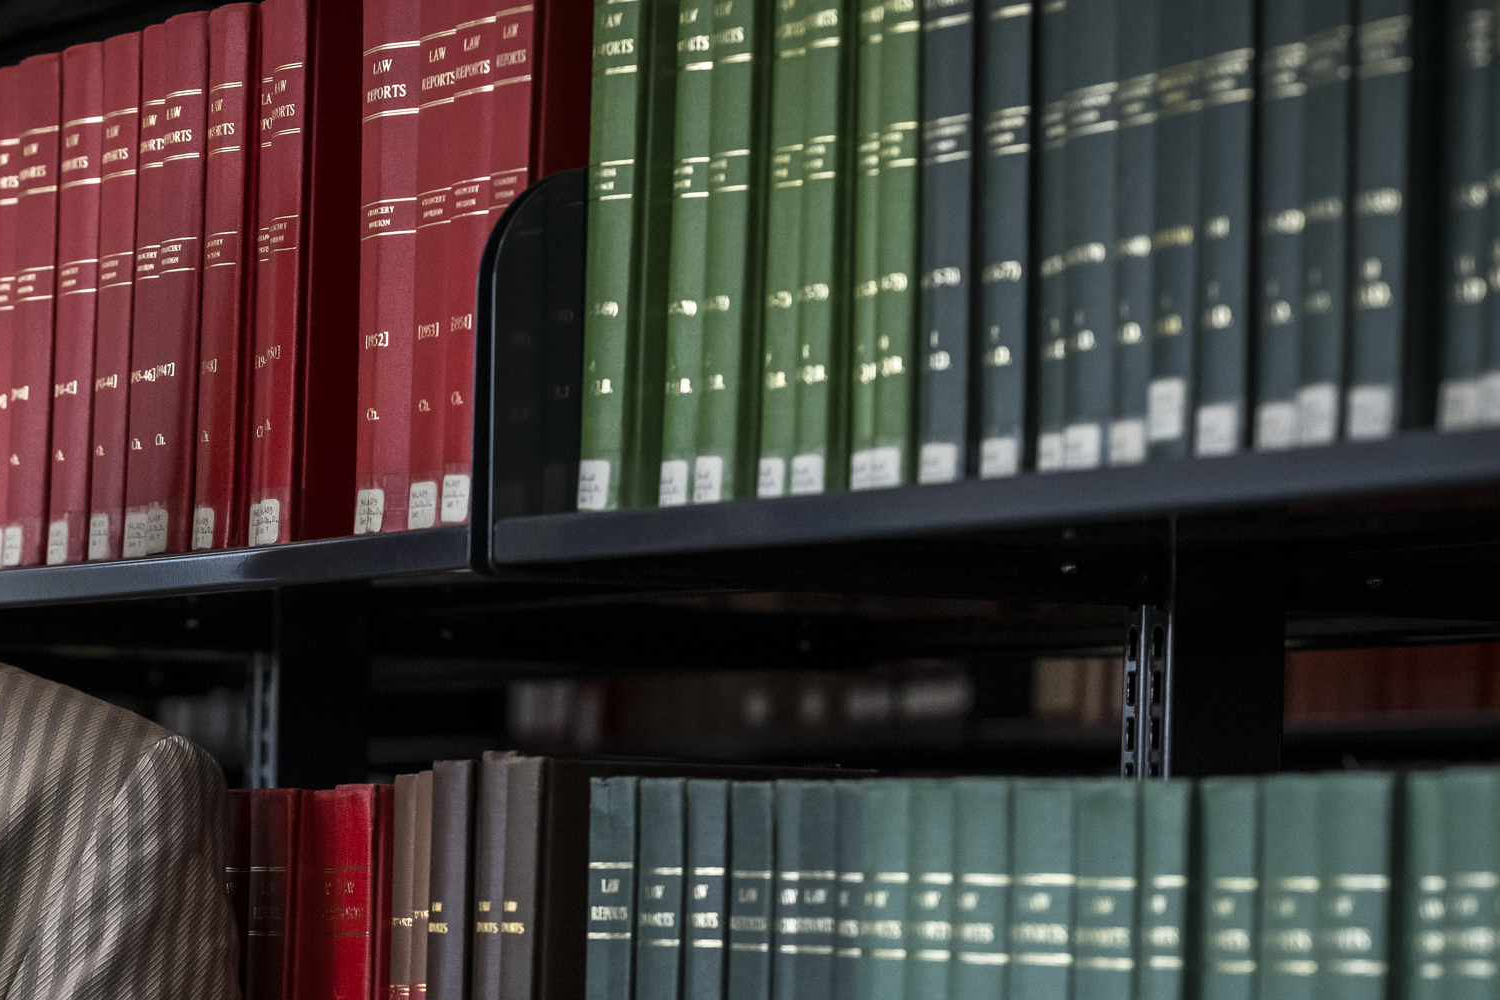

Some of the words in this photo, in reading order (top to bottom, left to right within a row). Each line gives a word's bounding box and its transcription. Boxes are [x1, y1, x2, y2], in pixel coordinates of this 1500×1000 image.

[503, 23, 519, 40] LAW
[464, 34, 481, 52] LAW
[429, 46, 447, 63] LAW
[373, 58, 393, 75] LAW
[456, 59, 491, 80] REPORTS
[275, 79, 288, 95] LAW
[421, 71, 456, 91] REPORTS
[366, 83, 407, 104] REPORTS
[167, 105, 182, 121] LAW
[418, 321, 440, 341] [1953]
[365, 331, 389, 350] [1952]
[366, 407, 380, 421] Ch.
[418, 398, 431, 413] Ch.
[131, 438, 142, 450] Ch.
[155, 433, 166, 446] Ch.
